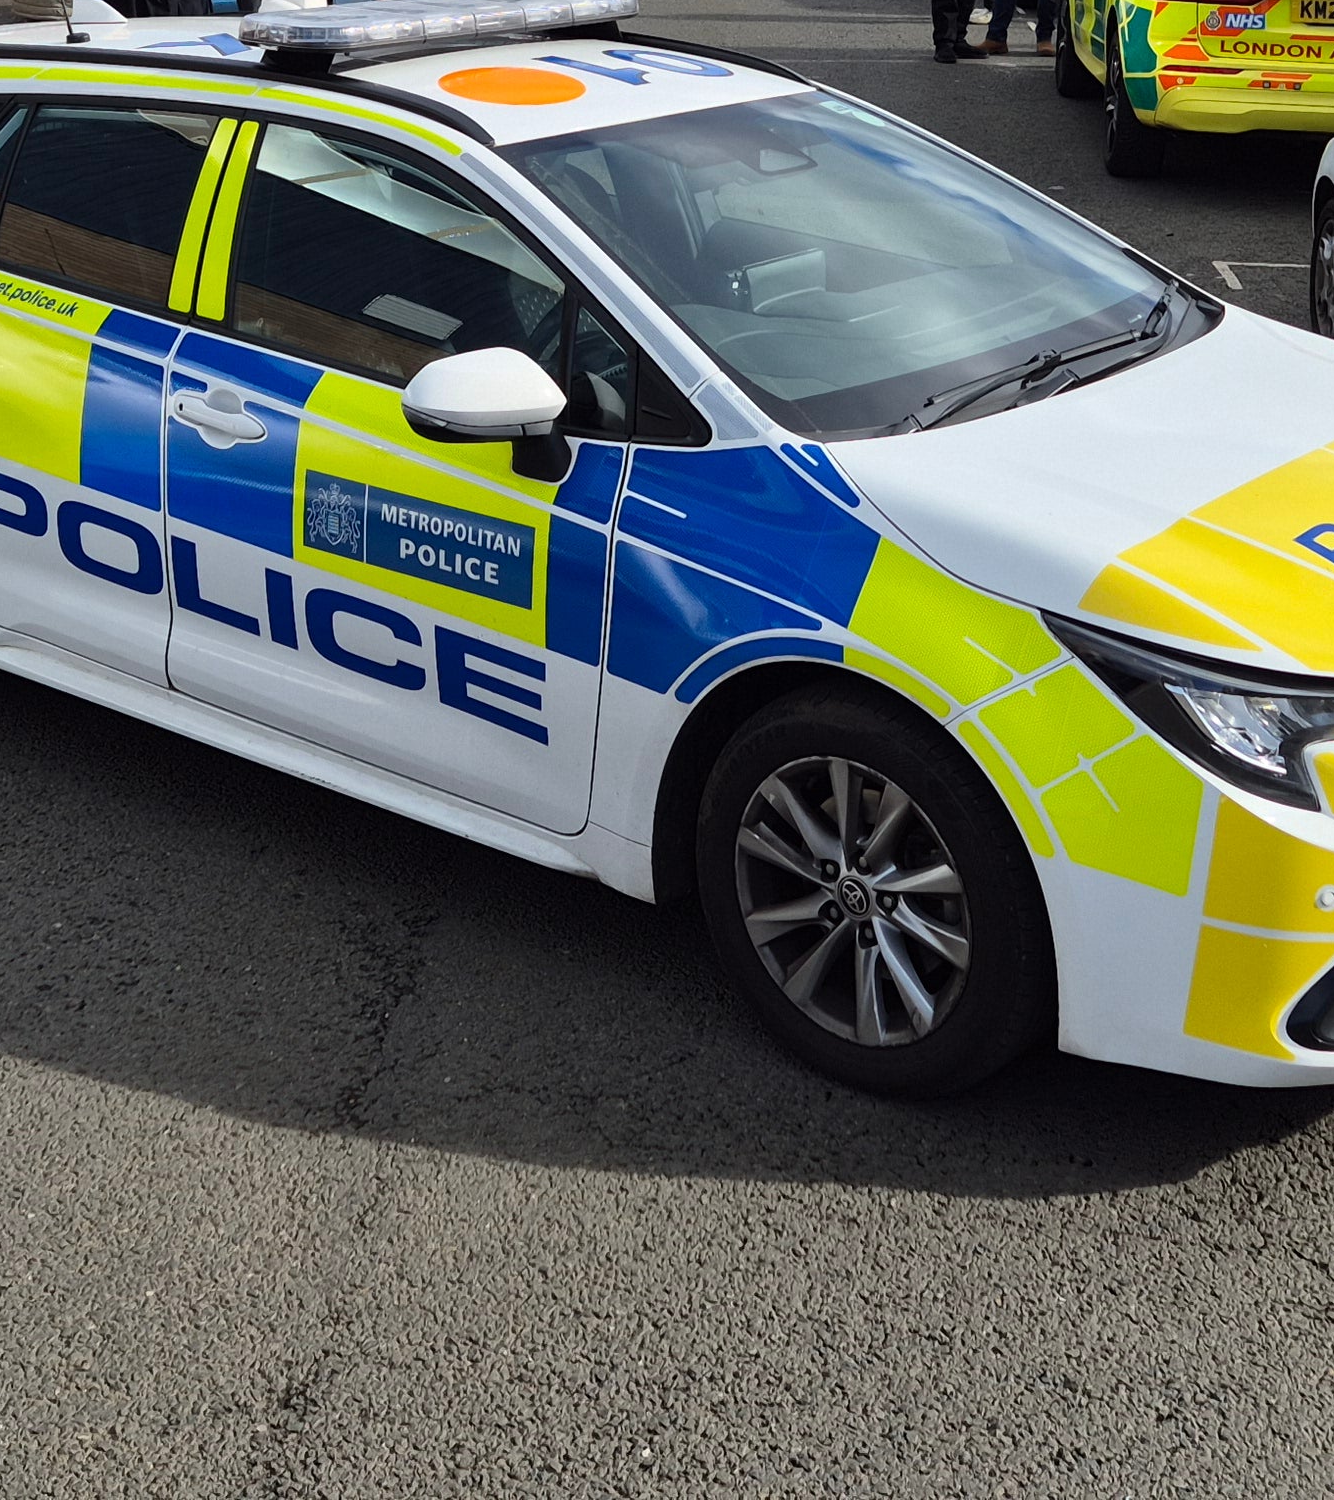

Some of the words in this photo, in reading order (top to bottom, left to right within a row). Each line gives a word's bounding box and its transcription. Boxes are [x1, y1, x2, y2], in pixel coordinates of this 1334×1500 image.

[1225, 13, 1265, 30] NHS
[1219, 40, 1322, 59] LONDON
[381, 503, 521, 557] METROPOLITAN
[399, 538, 499, 585] POLICE
